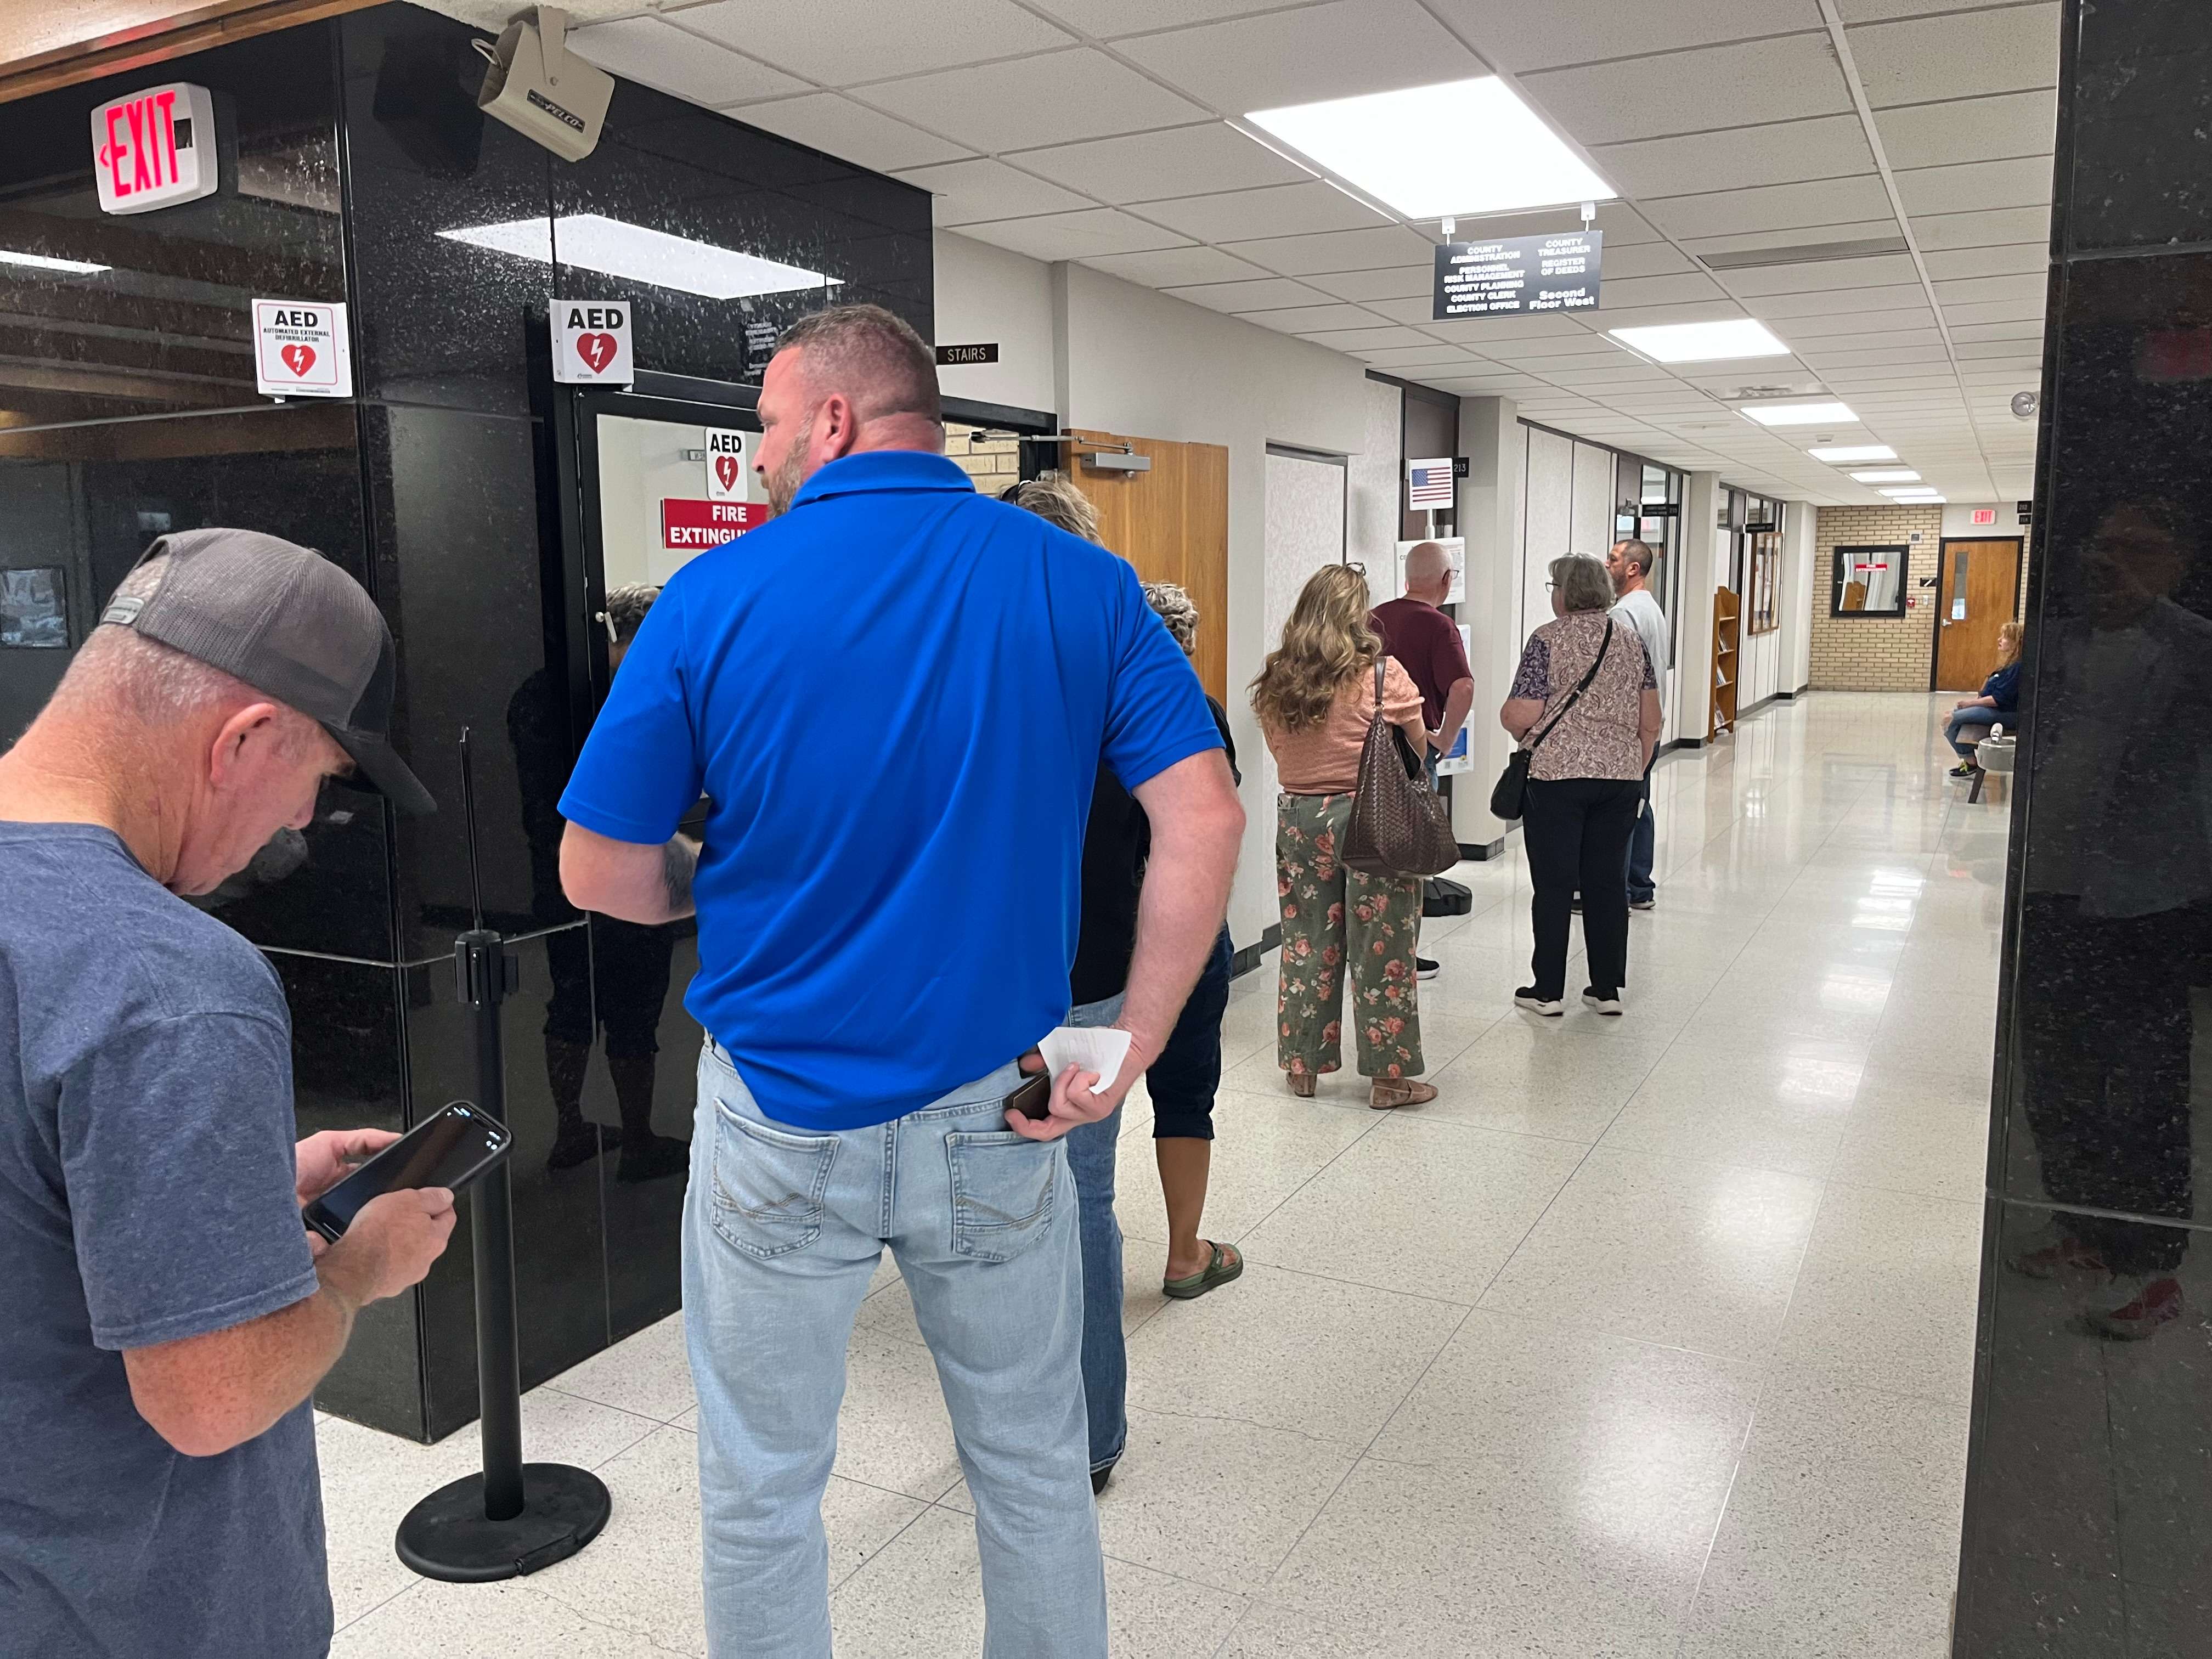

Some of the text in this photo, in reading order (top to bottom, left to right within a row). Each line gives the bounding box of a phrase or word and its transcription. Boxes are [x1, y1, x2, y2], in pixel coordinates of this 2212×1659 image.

[545, 104, 579, 126] PELCO
[105, 89, 179, 198] EXIT
[1545, 238, 1583, 248] COUNTY
[1467, 245, 1503, 255] COUNTY
[1538, 245, 1591, 257] TREASURER
[1450, 251, 1521, 264] ADMINISTRATION
[1542, 257, 1585, 268] REGISTER
[1459, 263, 1510, 274] PERSONNEL
[1541, 265, 1585, 276] OF DEEDS
[1444, 270, 1526, 284] RISK MANAGEMENT
[1444, 280, 1525, 294] COUNTY PLANNING
[1539, 287, 1585, 300] Second
[1451, 290, 1516, 303] COUNTY CLERK
[1529, 296, 1595, 310] Floor West
[1446, 301, 1520, 314] ELECTION OFFICE
[275, 310, 318, 328] AED
[567, 308, 624, 329] AED
[947, 347, 986, 362] STAIRS
[710, 434, 742, 453] AED
[1454, 464, 1466, 472] 213
[713, 505, 747, 522] FIRE
[1975, 510, 1993, 523] EXIT
[670, 527, 747, 545] EXTINGU
